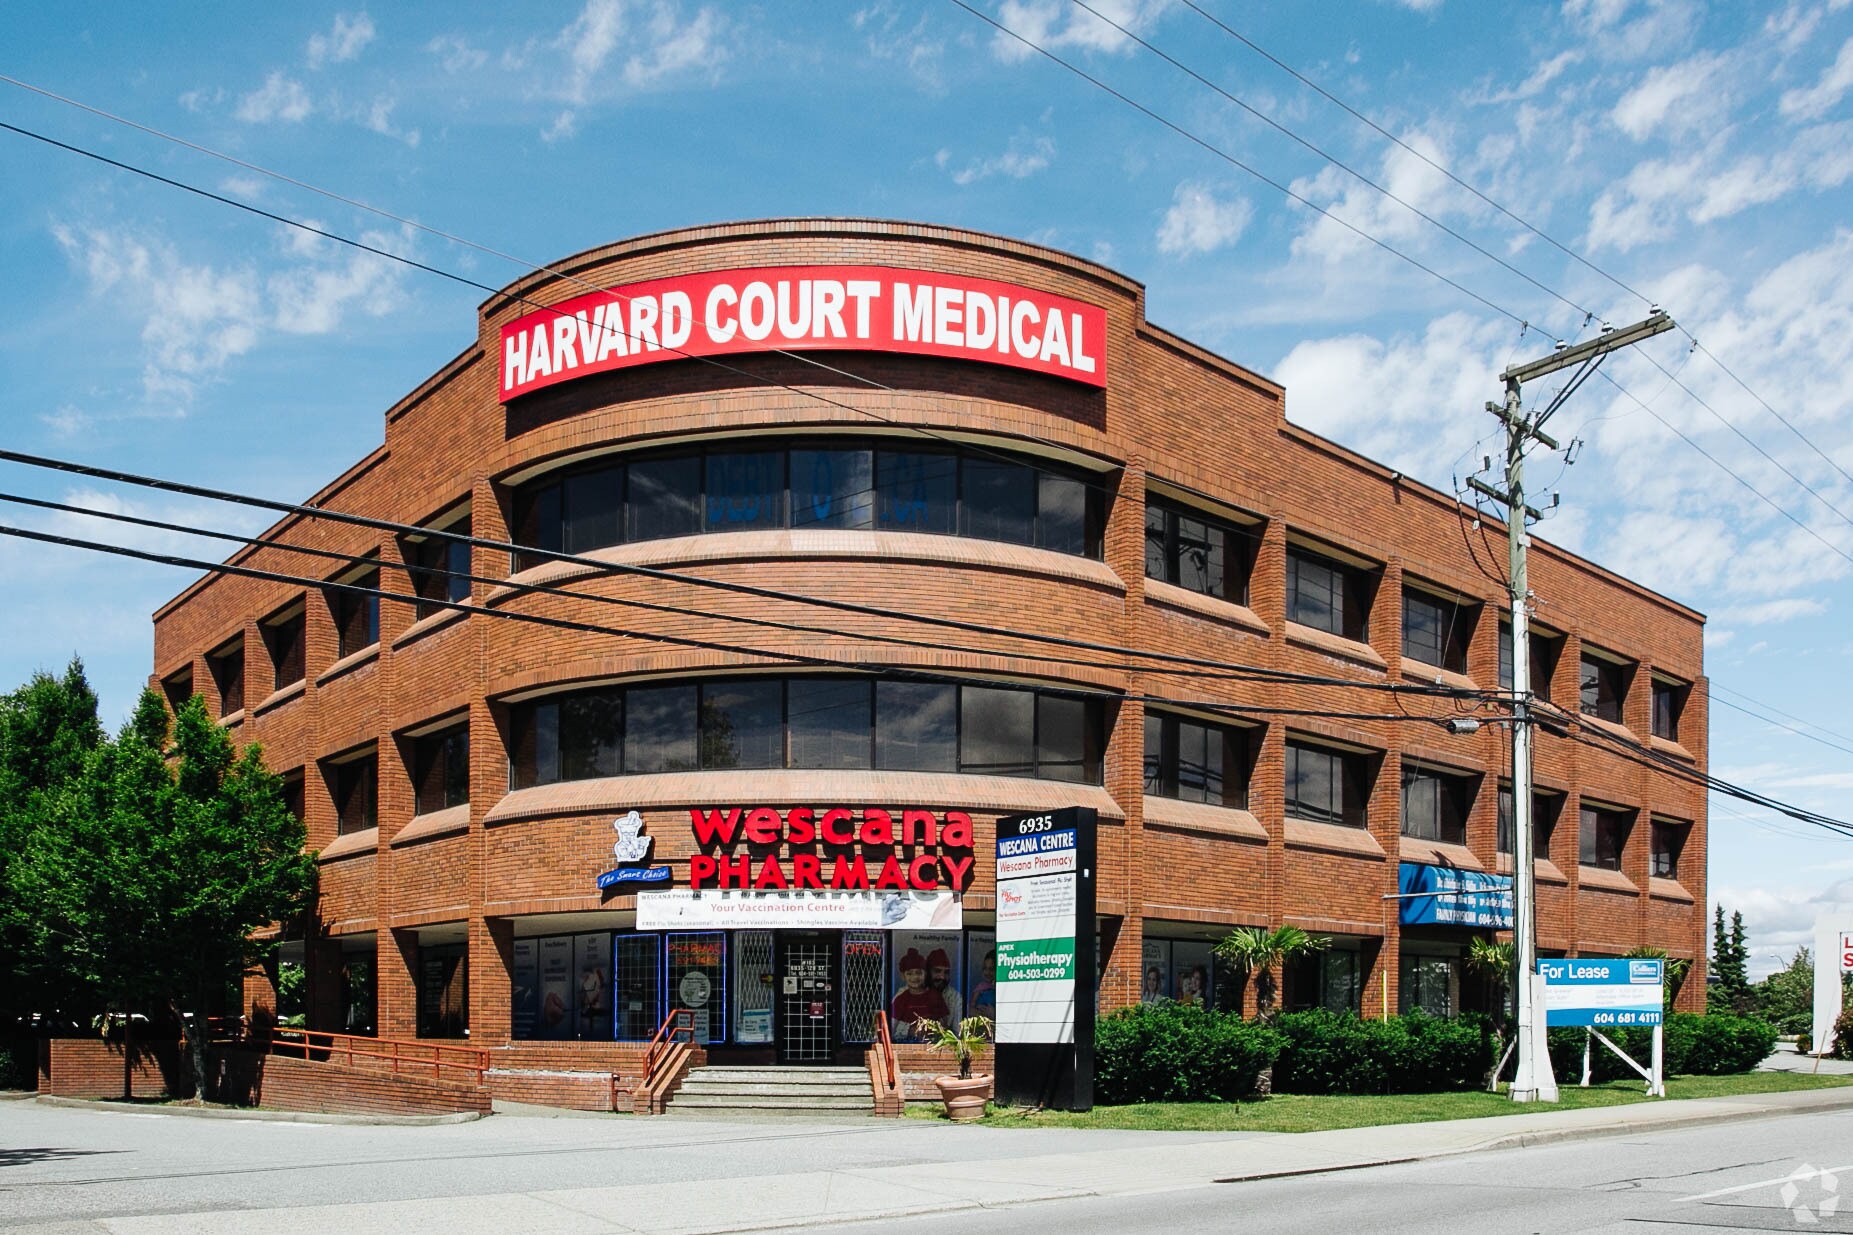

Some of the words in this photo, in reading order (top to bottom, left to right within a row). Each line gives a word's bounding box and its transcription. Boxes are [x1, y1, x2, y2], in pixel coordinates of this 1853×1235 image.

[504, 291, 692, 390] HARVARD
[704, 279, 880, 344] COURT
[893, 282, 1096, 374] MEDICAL
[1019, 815, 1052, 833] 6935
[999, 837, 1038, 856] WESCANA
[1040, 832, 1074, 851] CENTRE
[690, 854, 974, 890] PHARMACY
[1000, 861, 1031, 872] Wescana
[1034, 855, 1074, 869] Pharmacy
[600, 874, 614, 887] The
[617, 869, 641, 880] Smart
[642, 869, 667, 879] Choice
[710, 903, 735, 913] Your
[738, 903, 806, 913] Vaccination
[808, 903, 845, 912] Centre
[846, 943, 881, 955] OPEN
[997, 951, 1073, 970] Physiotherapy
[1008, 968, 1066, 980] 604-503-0299
[1540, 963, 1564, 979] For
[1568, 963, 1610, 979] Lease
[1594, 1013, 1615, 1024] 604
[1618, 1013, 1636, 1023] 681
[1638, 1012, 1660, 1023] 4111
